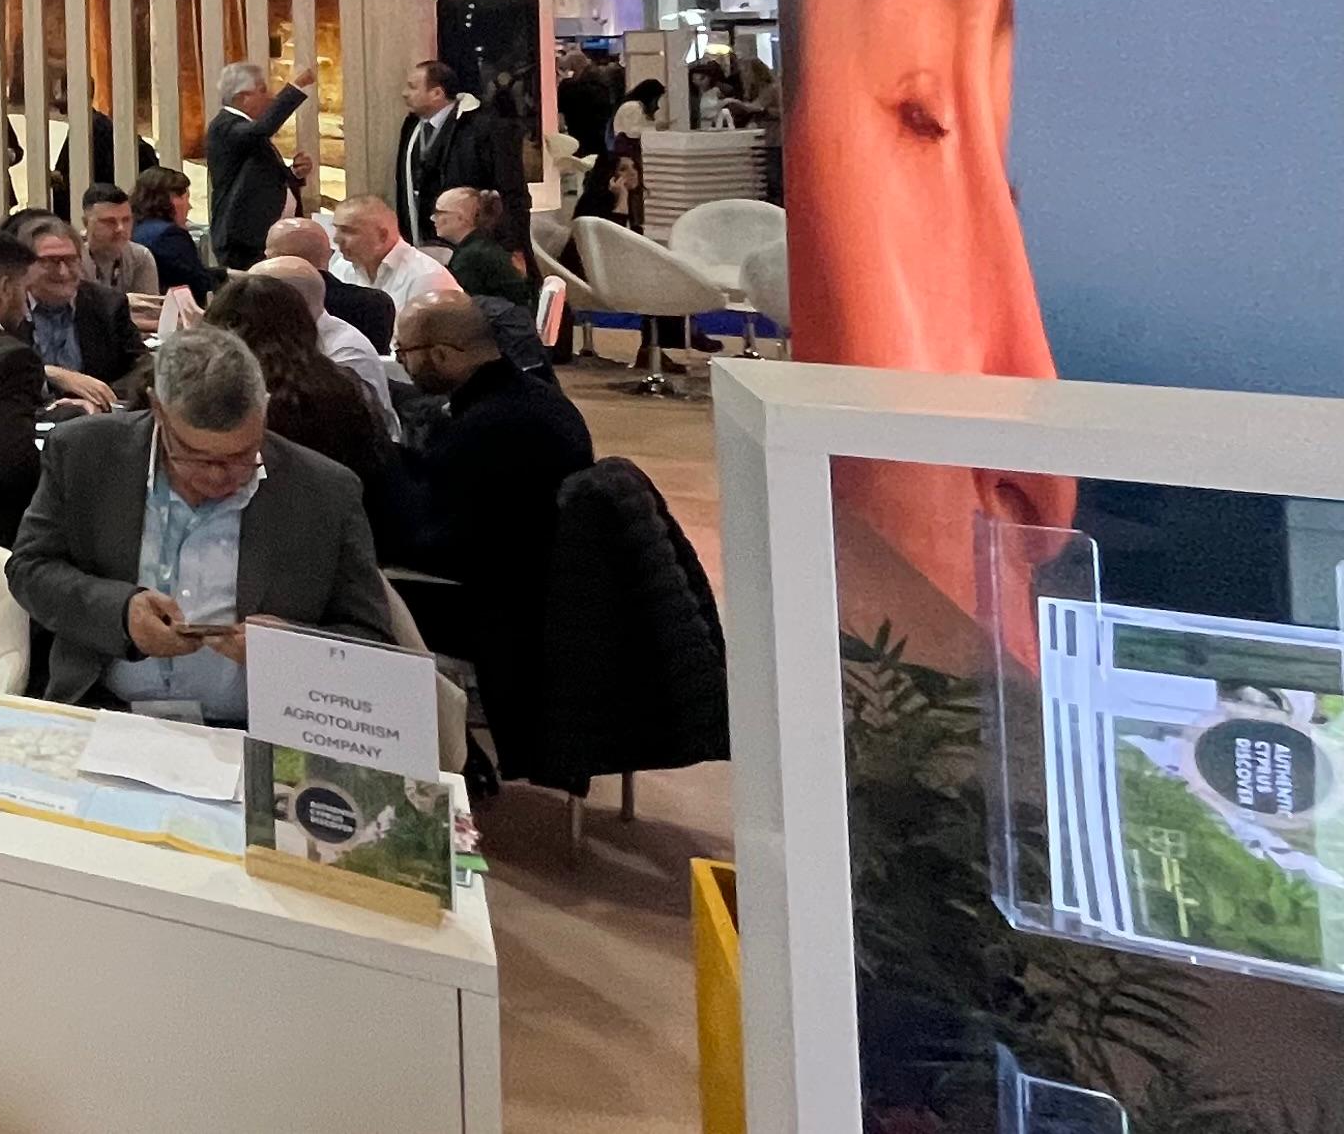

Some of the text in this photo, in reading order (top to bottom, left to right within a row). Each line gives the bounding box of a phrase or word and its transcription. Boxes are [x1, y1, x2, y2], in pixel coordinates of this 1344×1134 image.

[329, 647, 346, 660] F1
[308, 689, 372, 714] CYPRUS
[283, 705, 400, 742] AGROTOURISM
[302, 731, 382, 760] COMPANY
[1235, 737, 1254, 806] DISCOVER
[1254, 741, 1273, 794] CYPRUS
